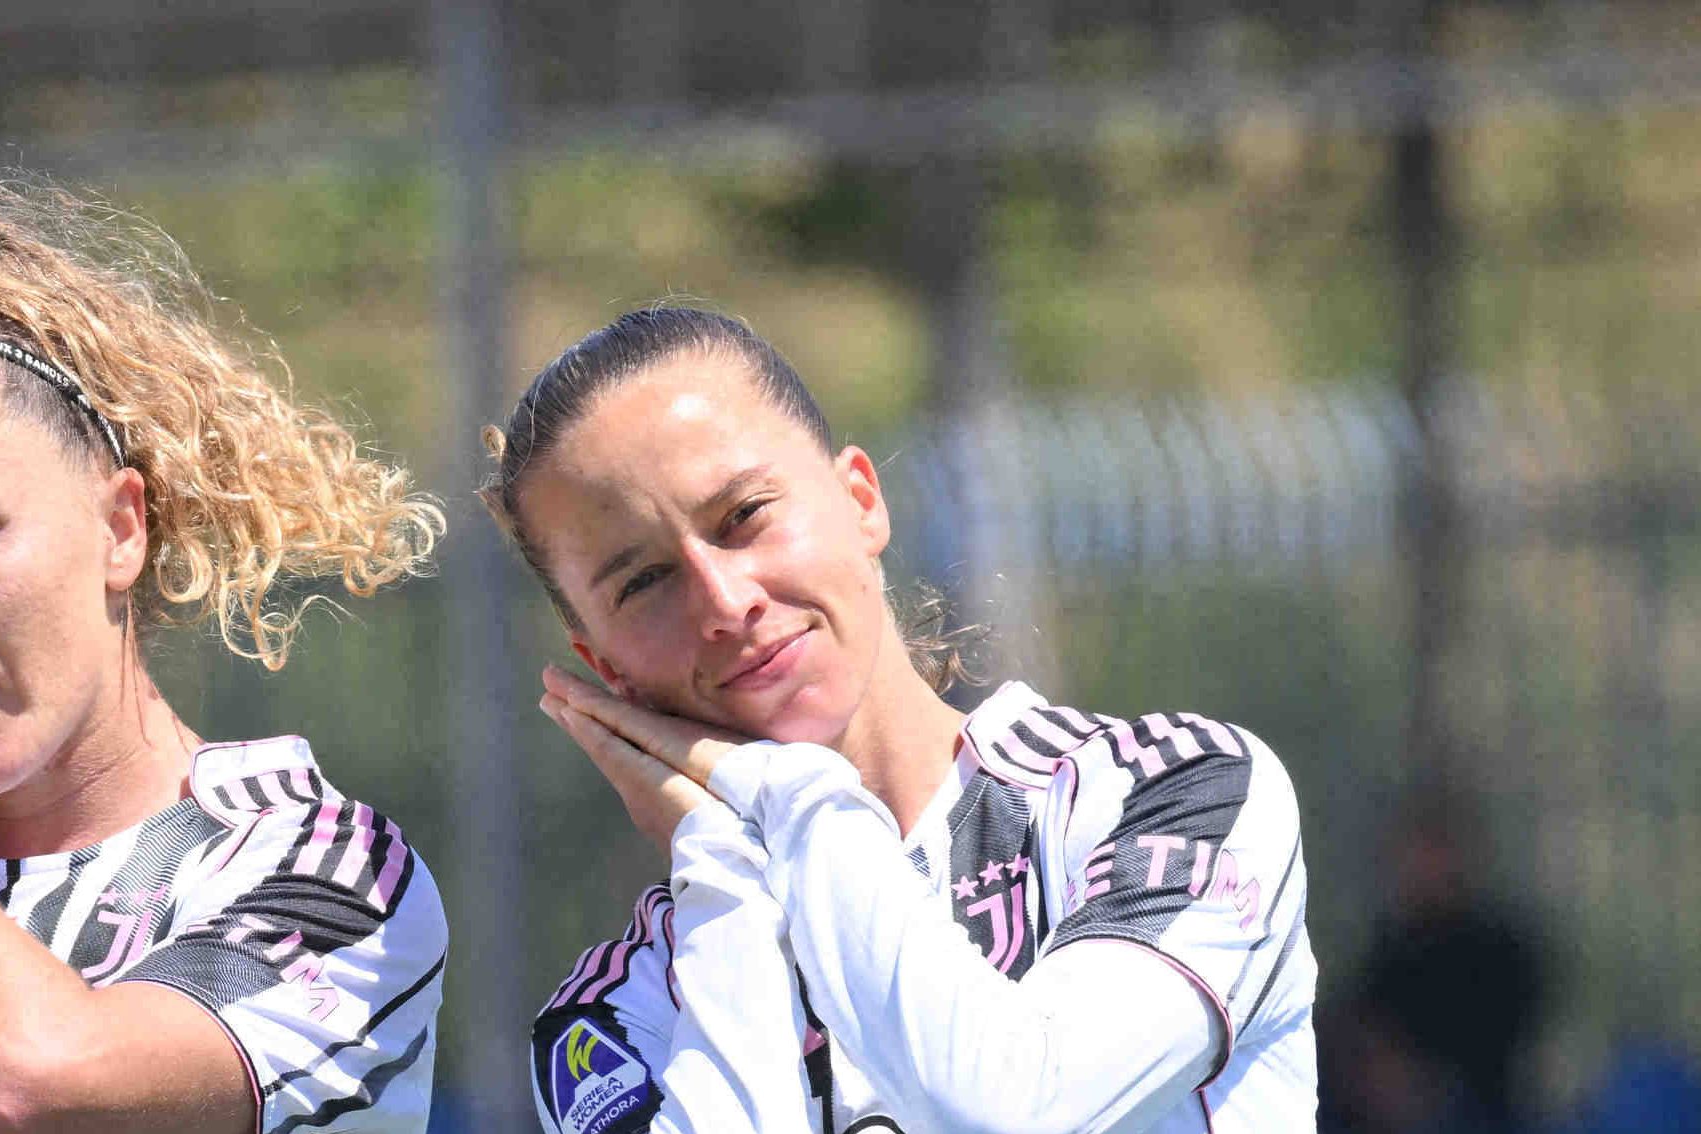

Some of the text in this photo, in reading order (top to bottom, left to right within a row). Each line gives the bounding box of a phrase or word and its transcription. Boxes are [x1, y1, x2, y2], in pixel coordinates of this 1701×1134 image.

[570, 1076, 619, 1122] SERIE A
[574, 1079, 625, 1130] WOMEN
